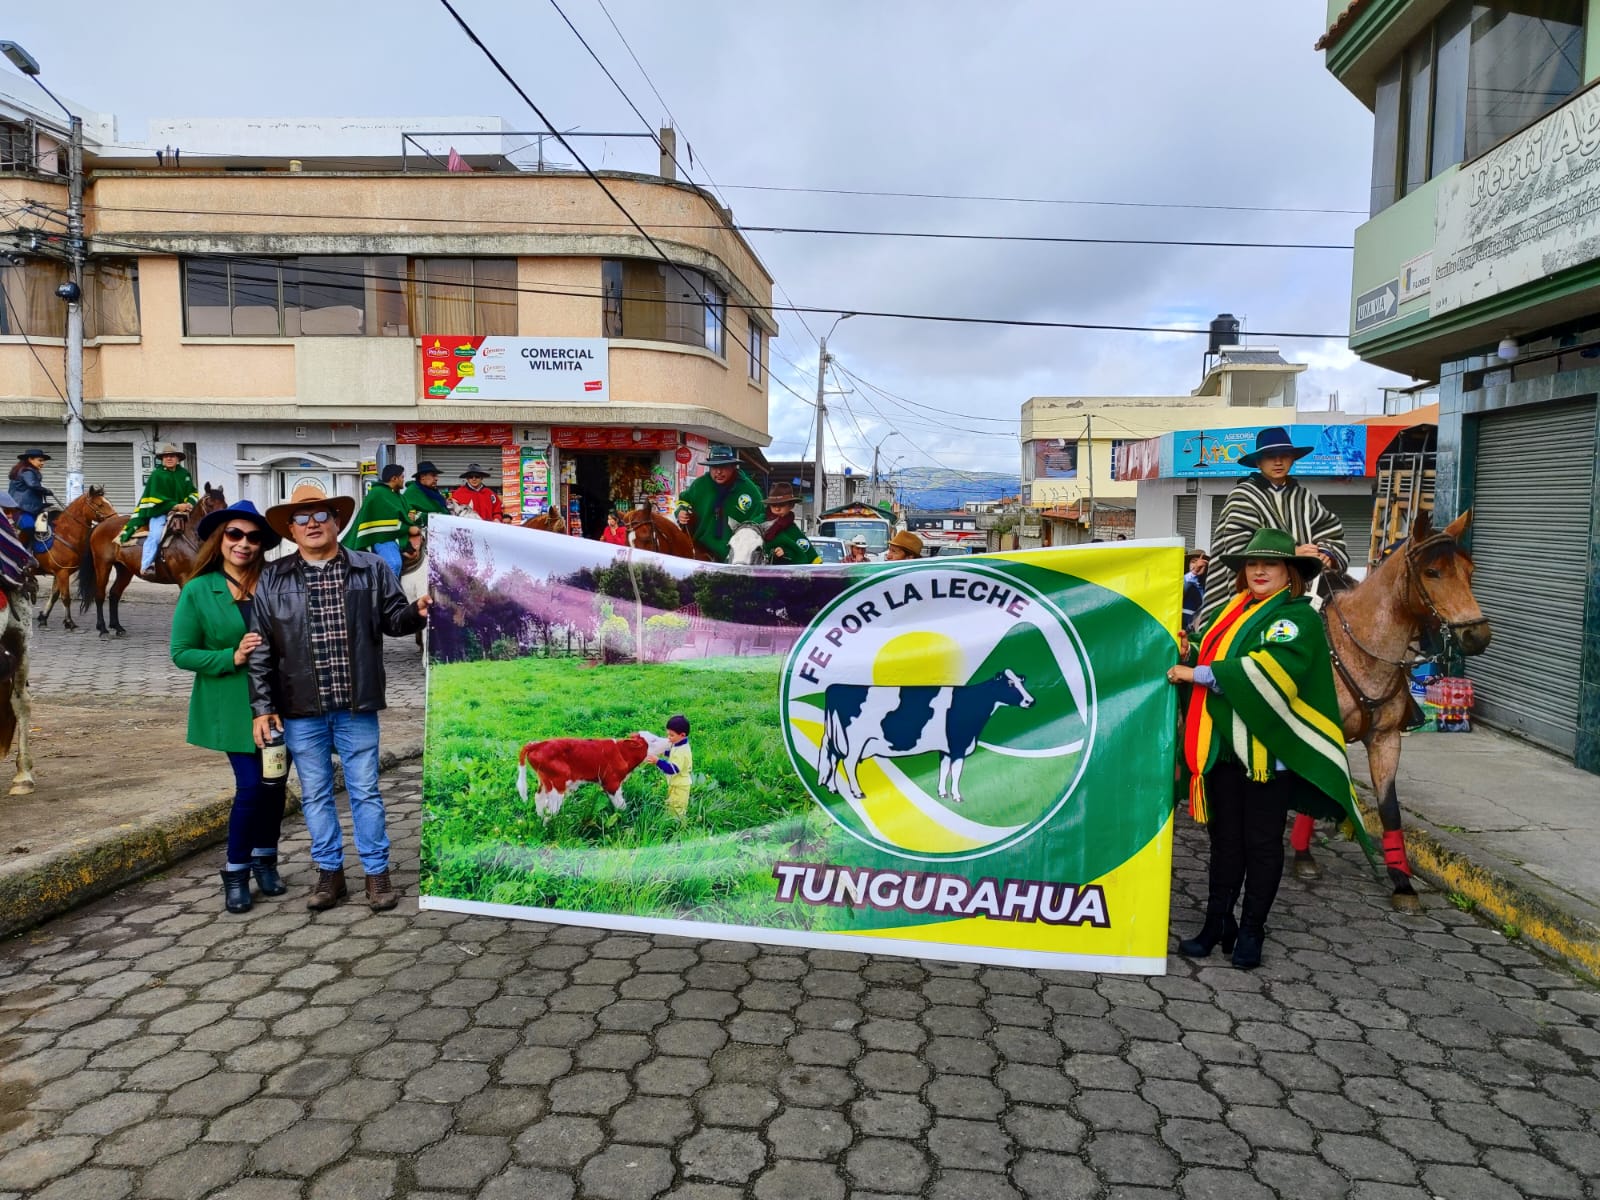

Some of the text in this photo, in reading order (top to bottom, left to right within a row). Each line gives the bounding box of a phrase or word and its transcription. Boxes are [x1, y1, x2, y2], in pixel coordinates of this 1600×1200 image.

[1470, 128, 1543, 208] Ferti
[1359, 302, 1372, 319] UNA
[521, 348, 594, 359] COMERCIAL
[529, 360, 583, 371] WILMITA
[1201, 443, 1248, 462] MACS
[800, 577, 1031, 685] FE POR LA LECHE
[775, 863, 1109, 927] TUNGURAHUA
